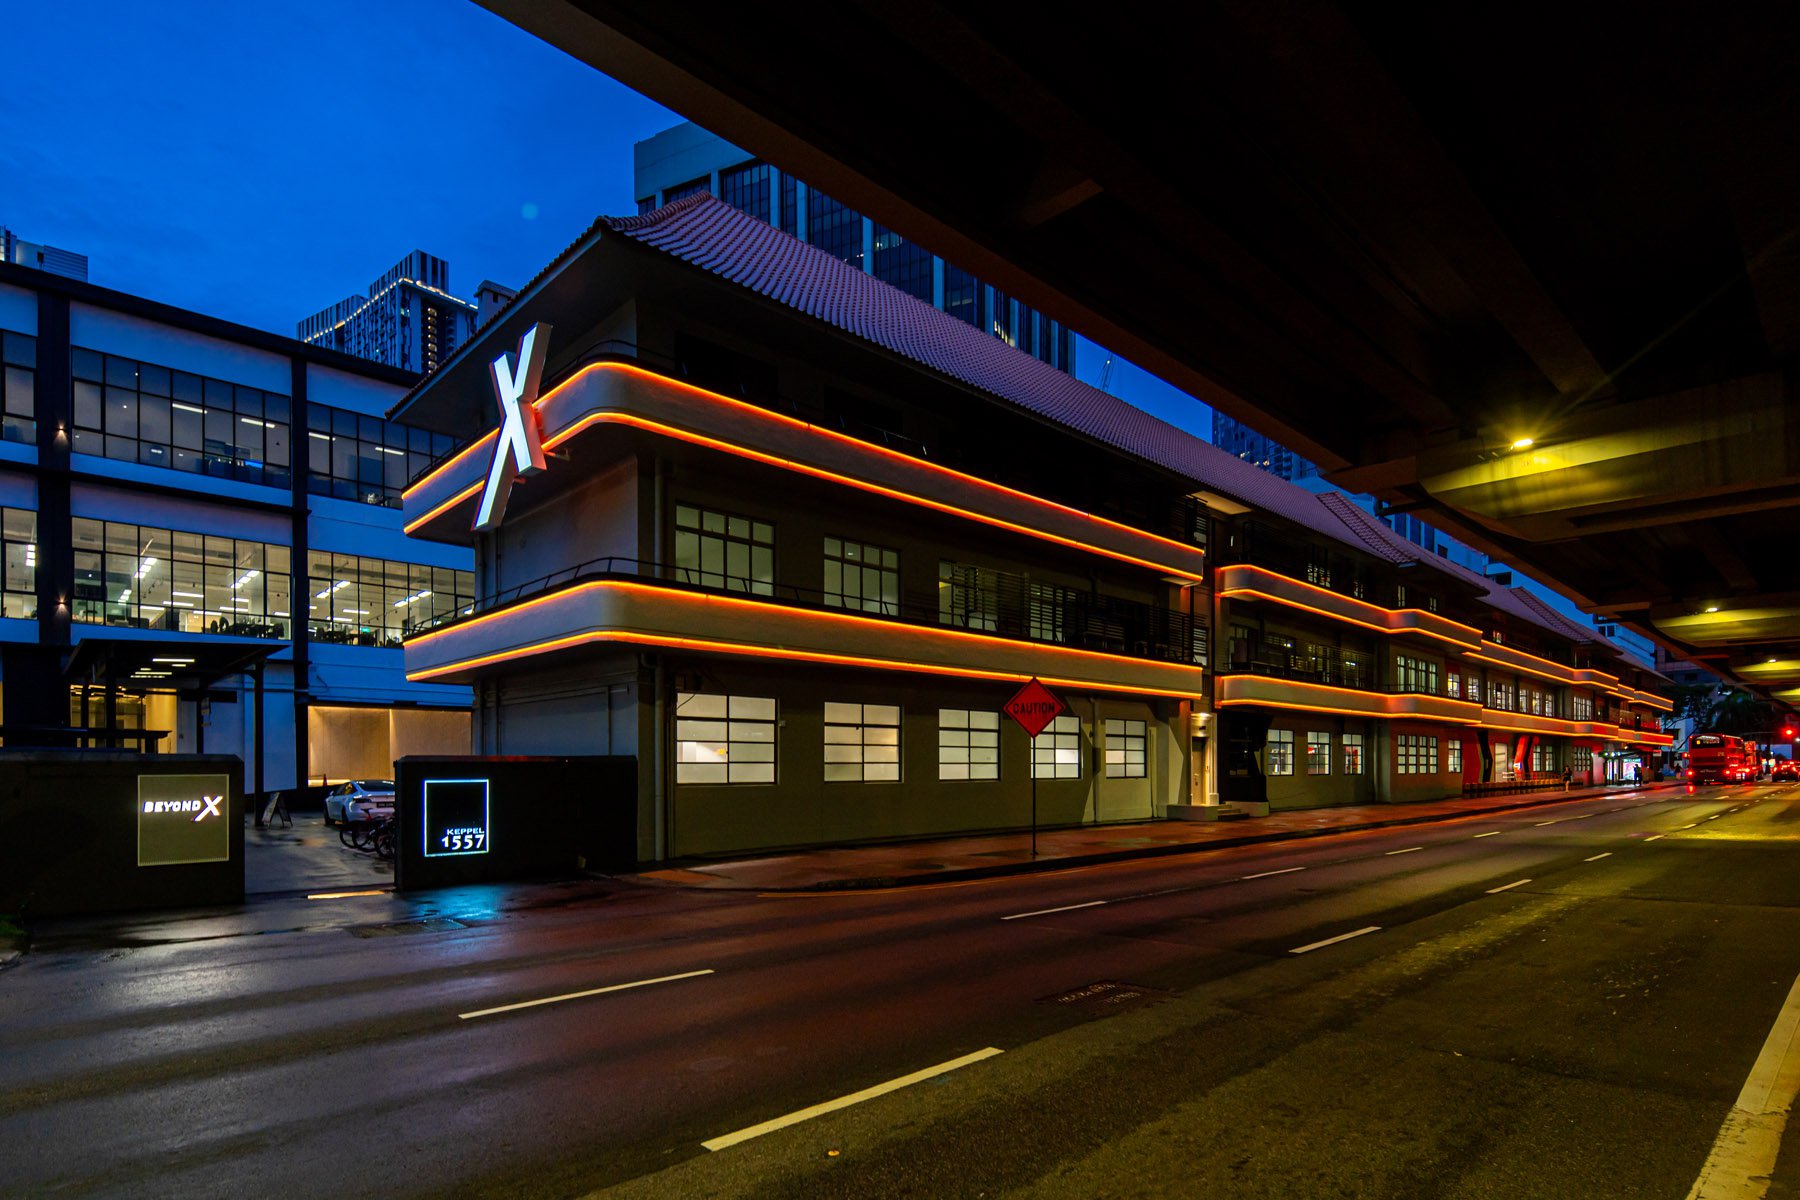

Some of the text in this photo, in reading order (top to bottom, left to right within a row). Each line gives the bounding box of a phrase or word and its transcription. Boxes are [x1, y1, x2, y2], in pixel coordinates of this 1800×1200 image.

[473, 322, 549, 531] X
[1013, 702, 1055, 714] CAUTION
[446, 827, 485, 836] KEPPEL
[441, 834, 485, 850] 1557
